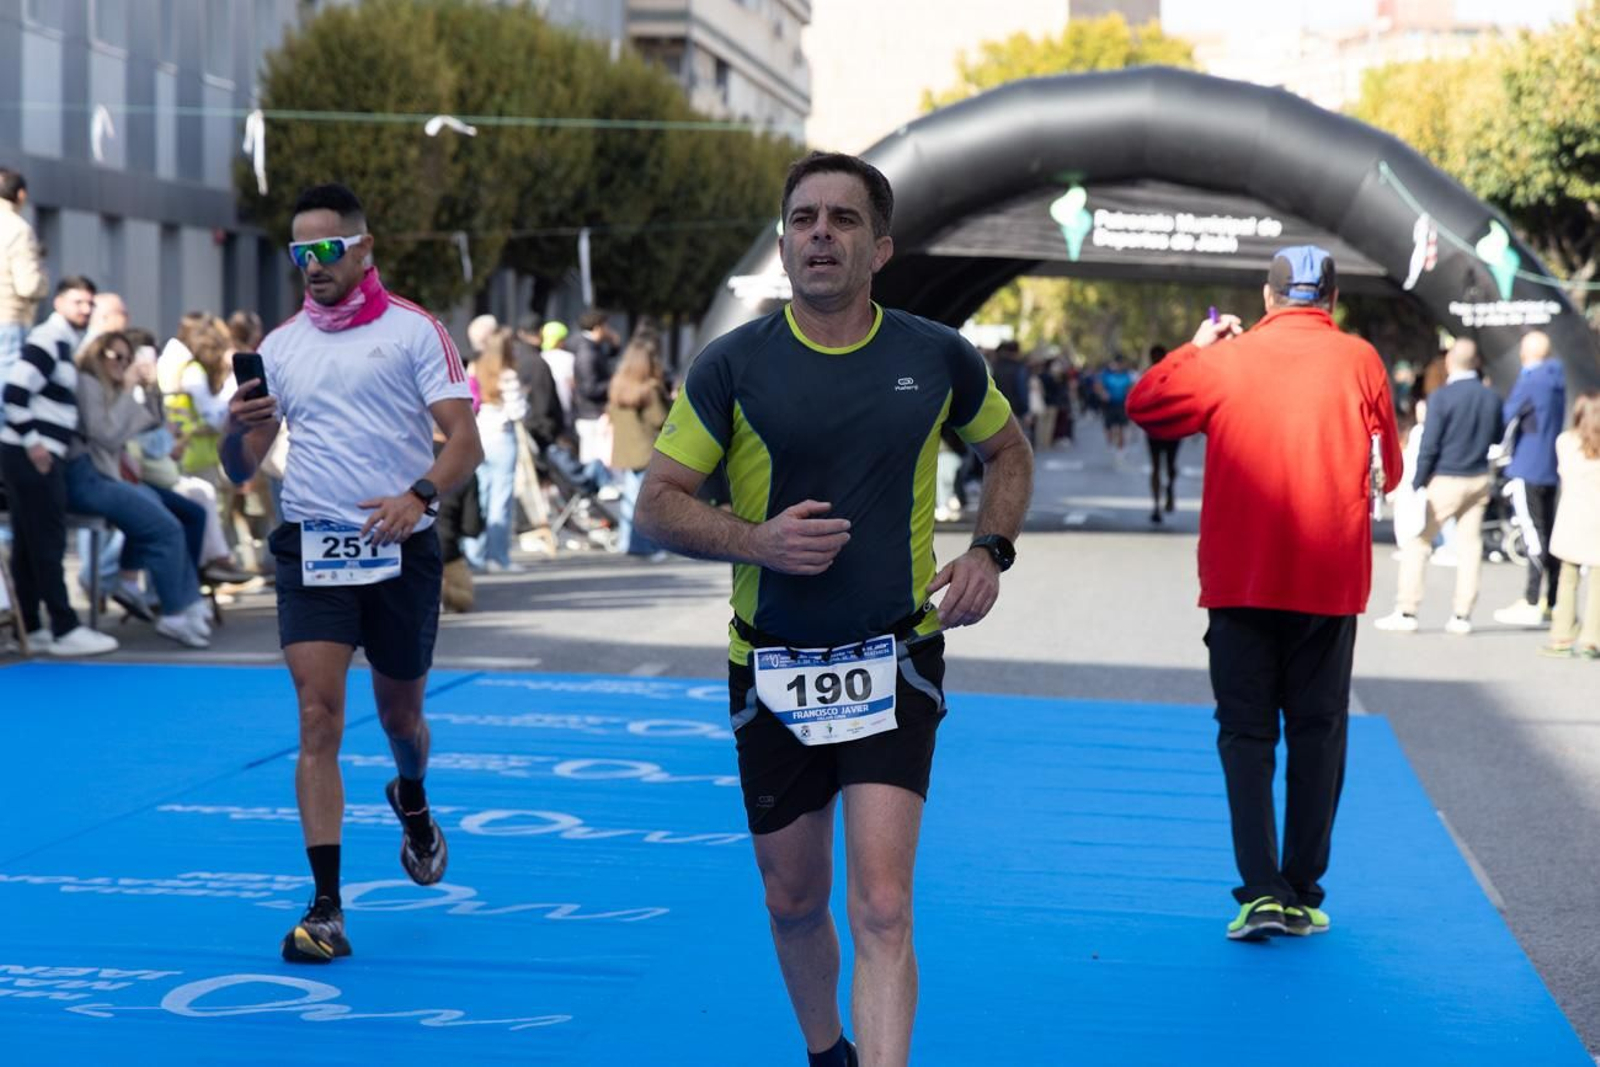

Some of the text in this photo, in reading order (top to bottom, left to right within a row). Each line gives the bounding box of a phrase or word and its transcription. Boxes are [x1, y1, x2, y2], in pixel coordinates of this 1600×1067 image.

[787, 668, 872, 707] 190
[793, 708, 838, 720] FRANCISCO
[841, 704, 869, 716] JAVIER
